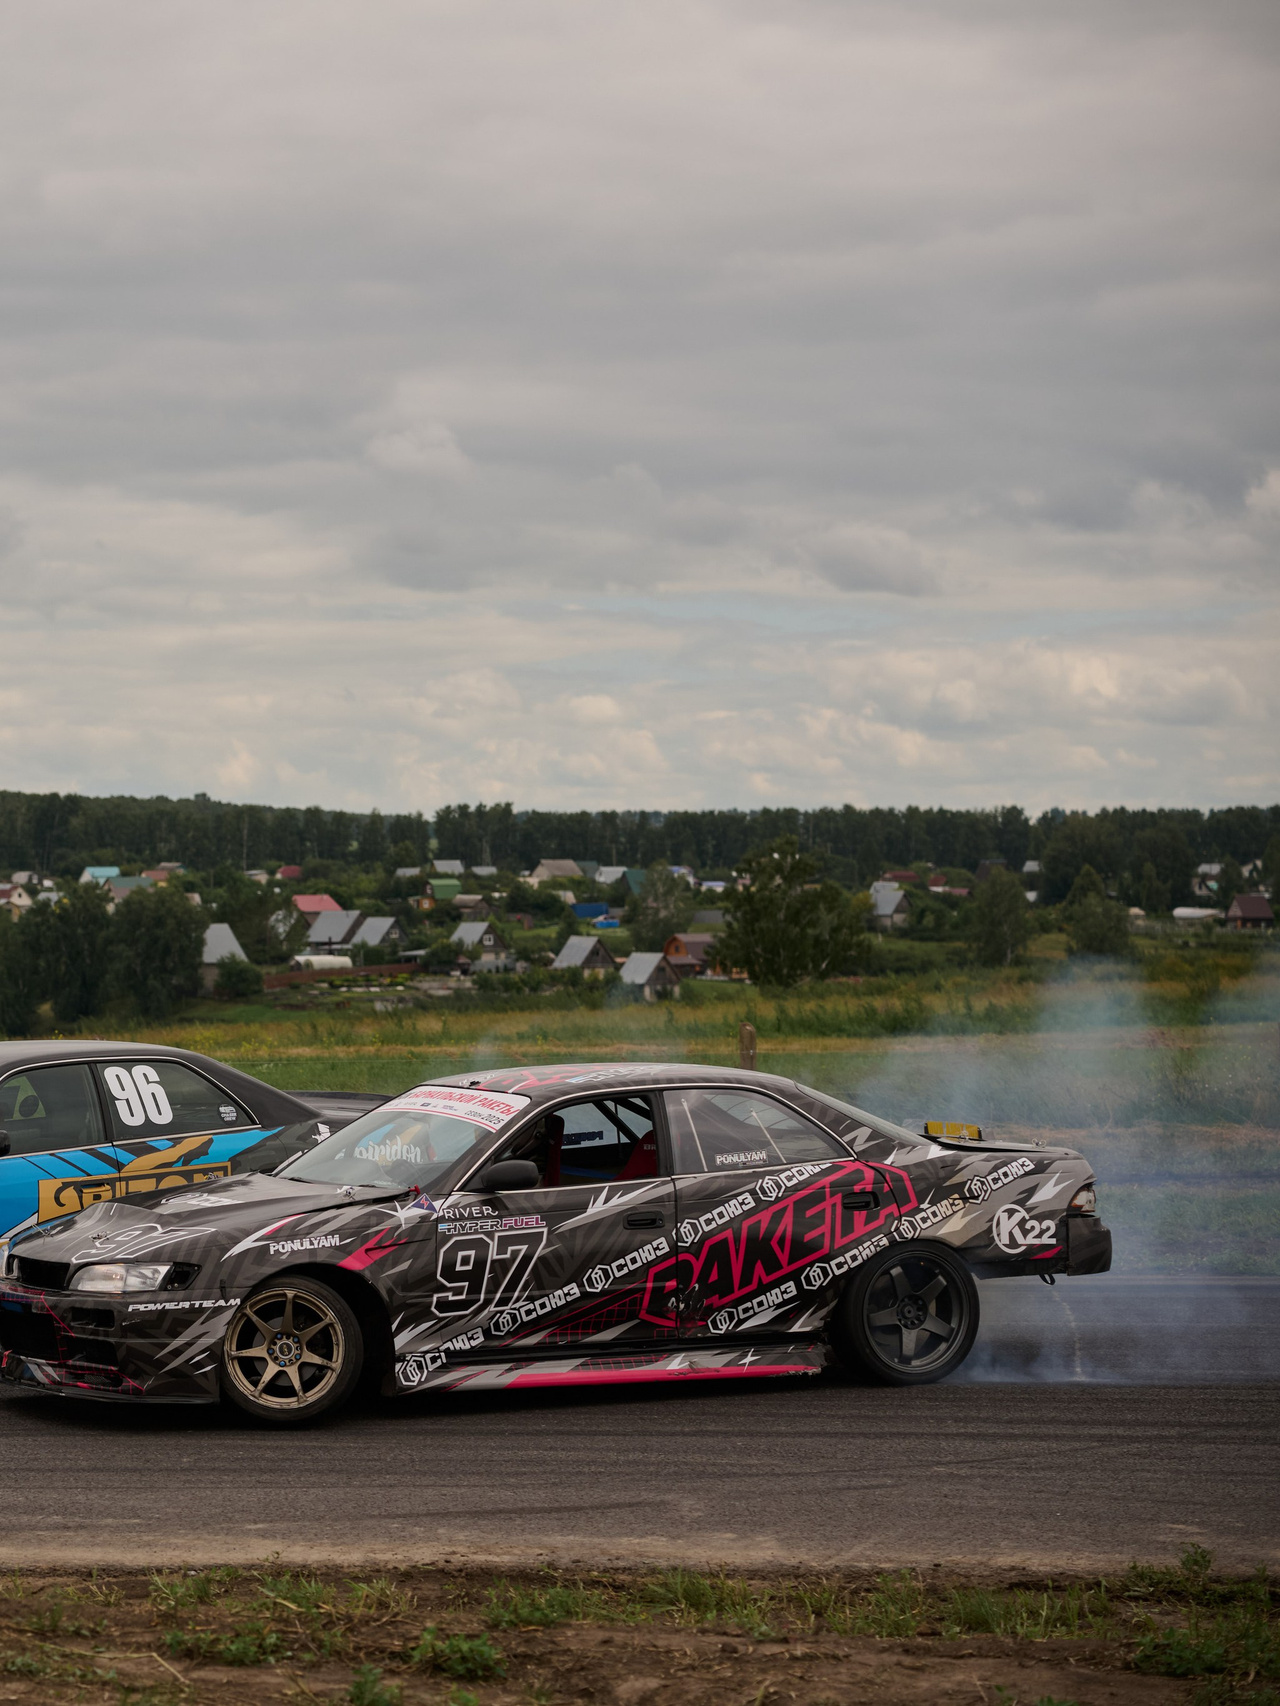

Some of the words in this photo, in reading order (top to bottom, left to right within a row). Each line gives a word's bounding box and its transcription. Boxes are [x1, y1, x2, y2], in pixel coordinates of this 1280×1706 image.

[103, 1064, 174, 1127] 96
[714, 1150, 767, 1165] PONULYAM
[443, 1206, 498, 1219] RIVER
[269, 1234, 340, 1254] PONULYAM
[431, 1227, 548, 1317] 97
